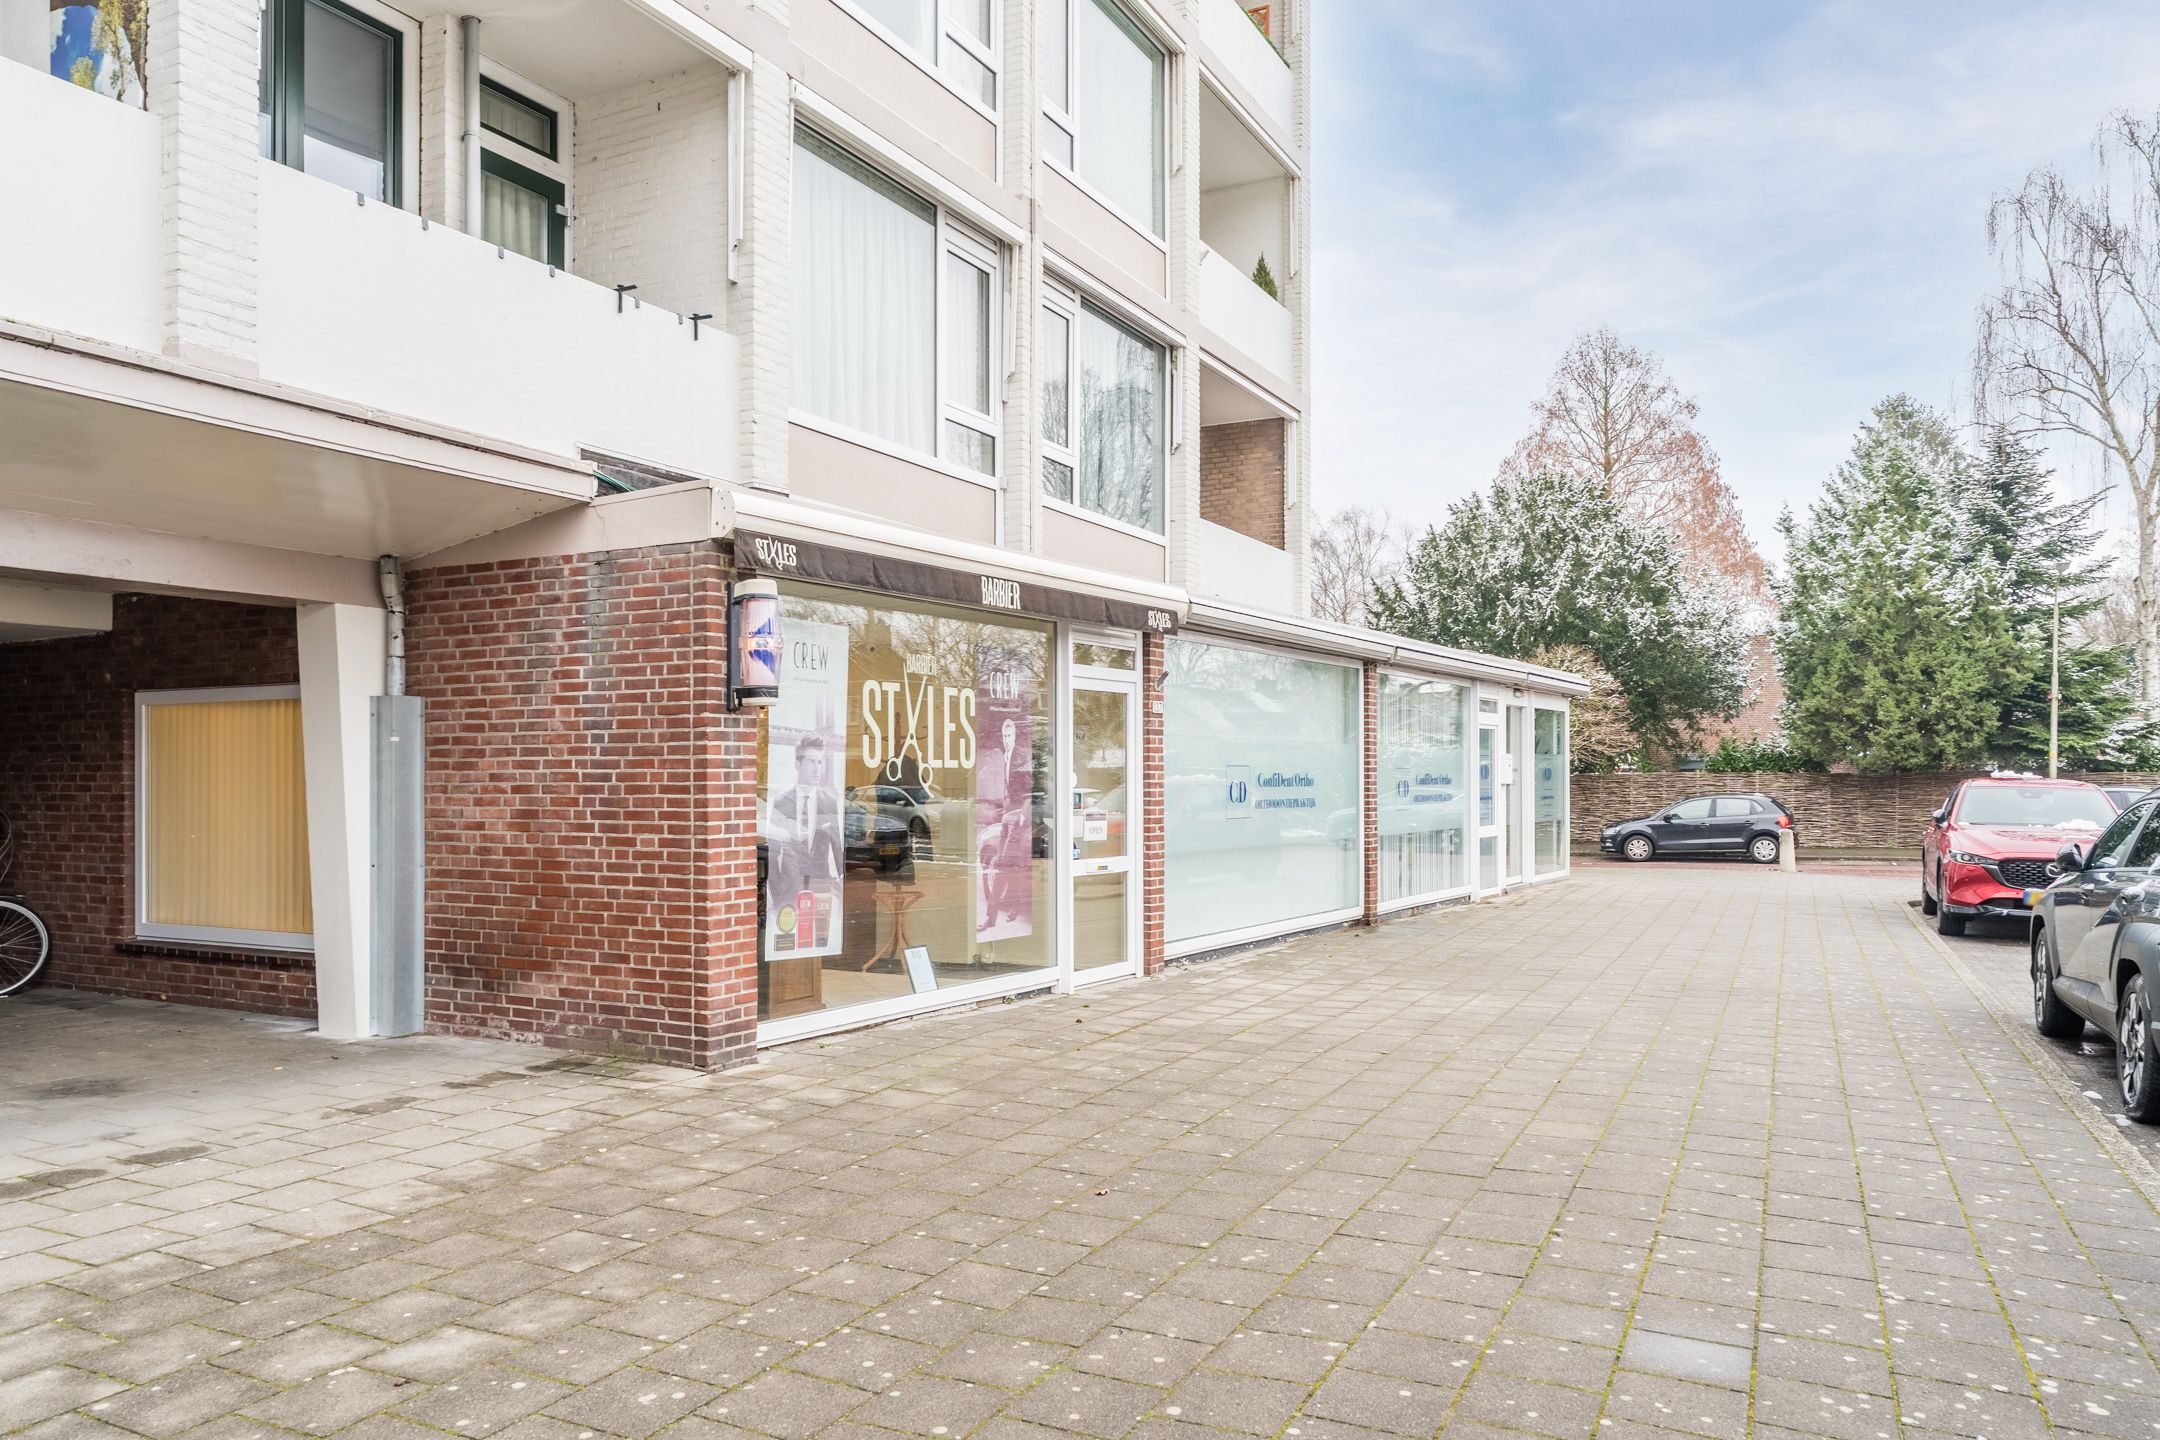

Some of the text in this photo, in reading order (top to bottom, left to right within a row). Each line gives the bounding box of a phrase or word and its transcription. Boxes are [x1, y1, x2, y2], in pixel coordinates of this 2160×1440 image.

[755, 536, 797, 570] STYLES
[981, 575, 1021, 610] BARBIER
[793, 641, 830, 672] CREW
[906, 653, 936, 676] BARBIER
[990, 671, 1019, 699] CREW
[862, 664, 976, 798] STYLES
[1229, 780, 1247, 803] CD
[1257, 772, 1314, 788] ConfiDent Ortho
